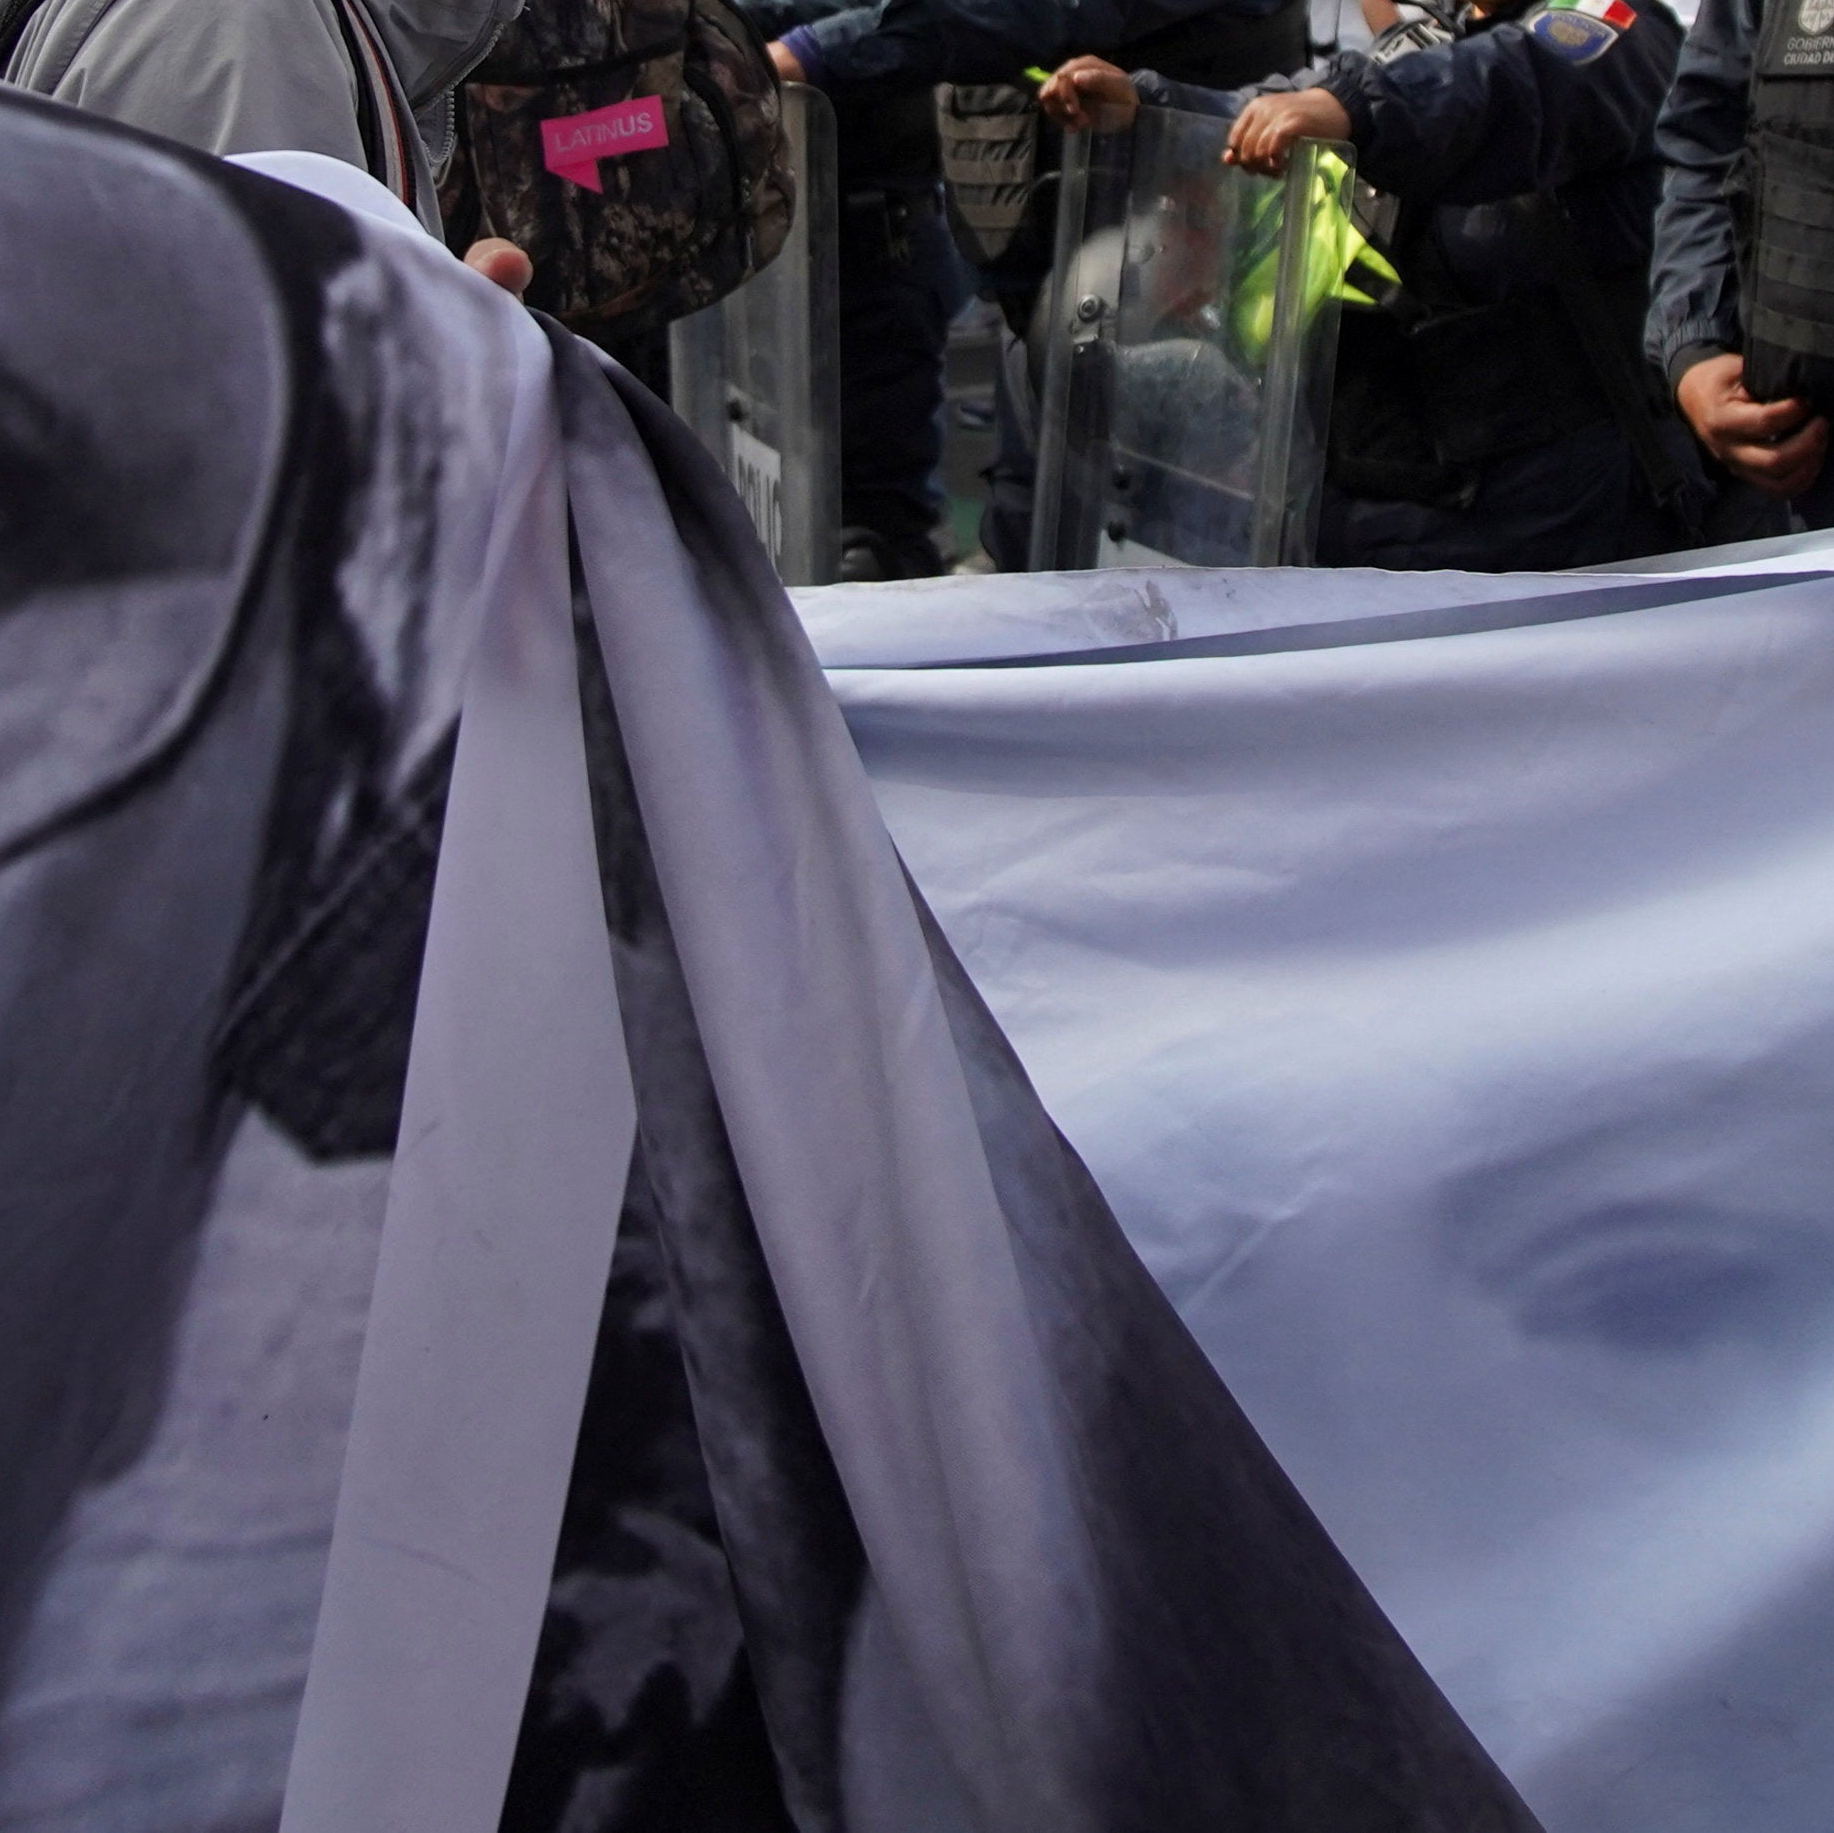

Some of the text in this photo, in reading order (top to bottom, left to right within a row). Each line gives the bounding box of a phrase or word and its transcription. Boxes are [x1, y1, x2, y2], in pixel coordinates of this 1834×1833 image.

[1784, 52, 1821, 65] CIUDAD
[1822, 52, 1834, 65] DE
[555, 113, 654, 152] LATINUS
